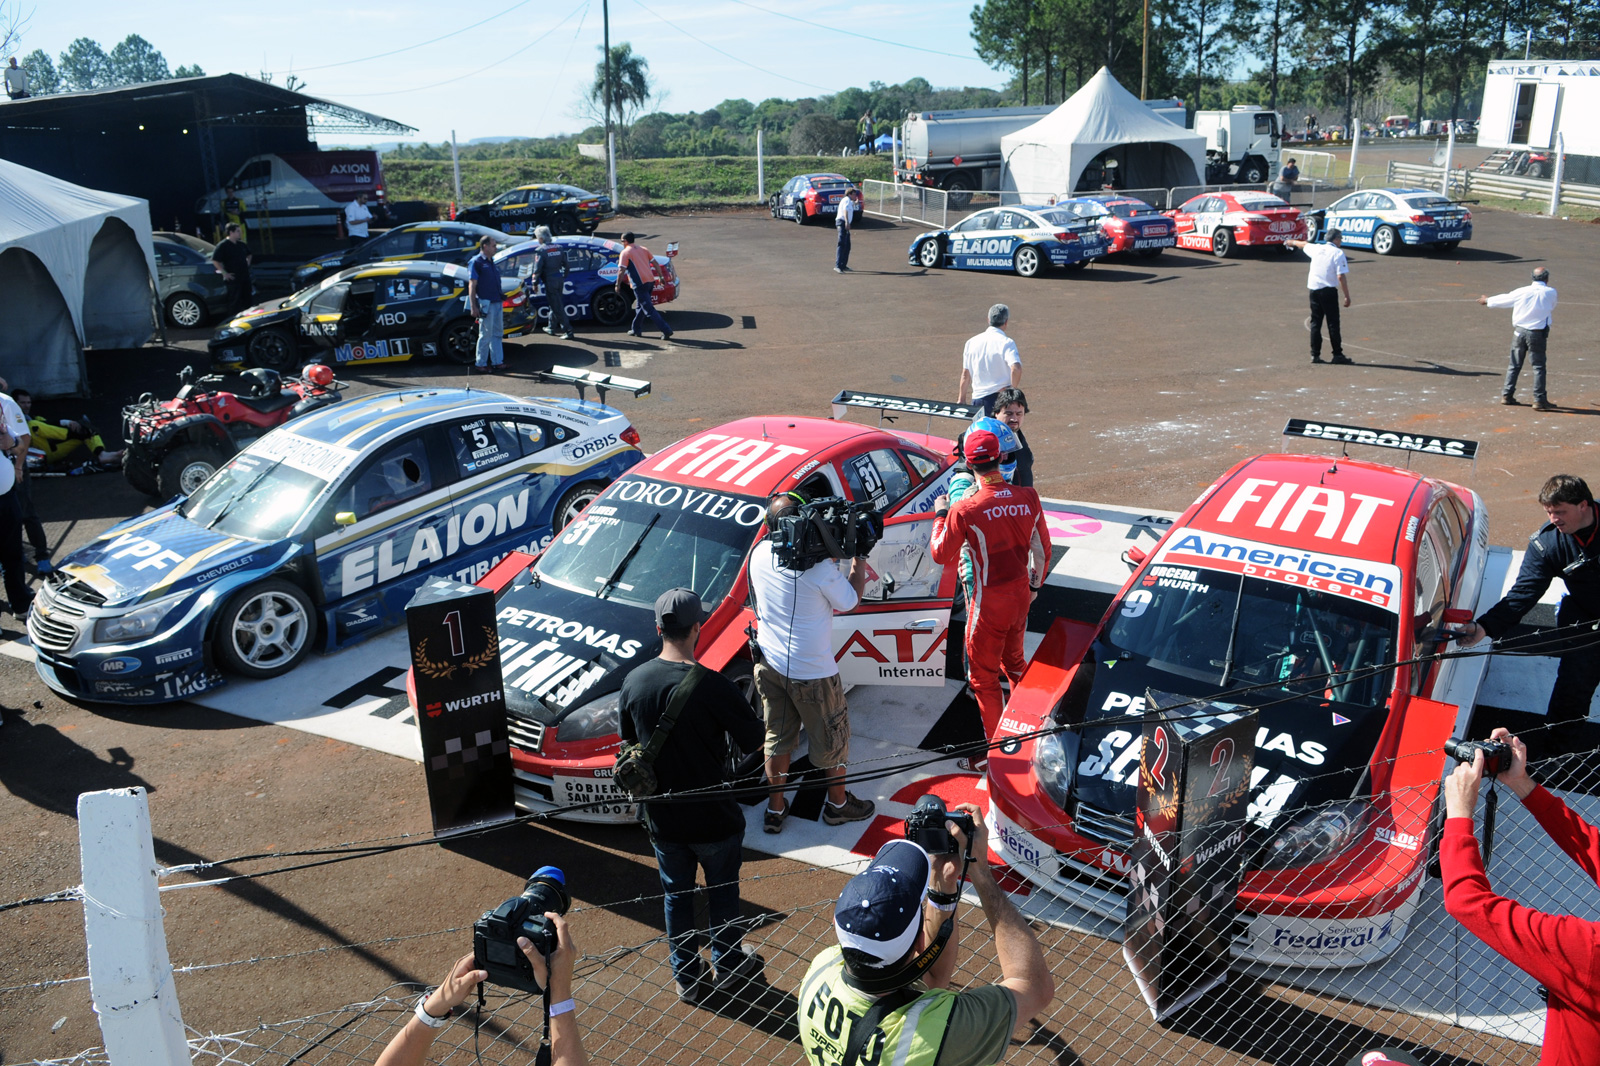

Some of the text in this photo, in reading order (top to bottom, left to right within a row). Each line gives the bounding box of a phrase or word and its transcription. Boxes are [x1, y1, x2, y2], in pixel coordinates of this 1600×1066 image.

[330, 163, 370, 174] AXION
[355, 174, 371, 183] lab
[489, 207, 536, 218] PLAN ROMBO
[1326, 218, 1375, 232] ELAION
[1438, 219, 1458, 228] YPF
[432, 236, 442, 244] 21
[1082, 234, 1097, 245] YPF
[1134, 238, 1175, 248] MULTIBANDAS
[1182, 236, 1210, 249] TOYOTA
[1438, 230, 1463, 240] CRUZE
[952, 238, 1012, 254] ELAION
[1083, 248, 1103, 257] CRUZE
[966, 258, 1013, 267] MULTIBANDAS
[397, 282, 405, 292] 4
[334, 340, 388, 362] Mobil
[462, 421, 479, 432] Mobil
[472, 428, 489, 448] 5
[1302, 423, 1466, 456] PETRONAS
[472, 444, 499, 460] PIRELLI
[572, 434, 618, 459] ORBIS
[476, 452, 509, 468] Canapino
[652, 433, 809, 487] FIAT
[859, 462, 882, 492] 31
[919, 484, 948, 513] DANIEL
[983, 504, 1032, 520] TOYOTA
[1217, 478, 1394, 545] FIAT
[562, 520, 602, 546] 31
[341, 488, 530, 597] ELAION
[102, 533, 186, 572] YPF
[196, 554, 254, 582] CHEVROLET
[1169, 535, 1394, 595] American
[1150, 566, 1198, 582] URCERA
[1242, 563, 1386, 605] brokers
[1120, 590, 1153, 618] 9
[346, 614, 378, 627] DIADORA
[443, 610, 465, 657] 1
[496, 606, 643, 659] PETRONAS
[155, 648, 193, 664] PIRELLI
[103, 661, 124, 672] MR
[878, 666, 943, 678] Internac
[445, 689, 502, 713] WÜRTH
[1002, 718, 1036, 733] SILOC
[1151, 726, 1170, 790] 2
[1206, 737, 1235, 798] 2
[566, 782, 622, 794] GOBIER
[568, 792, 592, 803] SAN
[990, 810, 1040, 867] Federal
[1273, 926, 1374, 950] Federal
[916, 944, 941, 969] Nikon
[810, 1028, 837, 1056] SUPER
